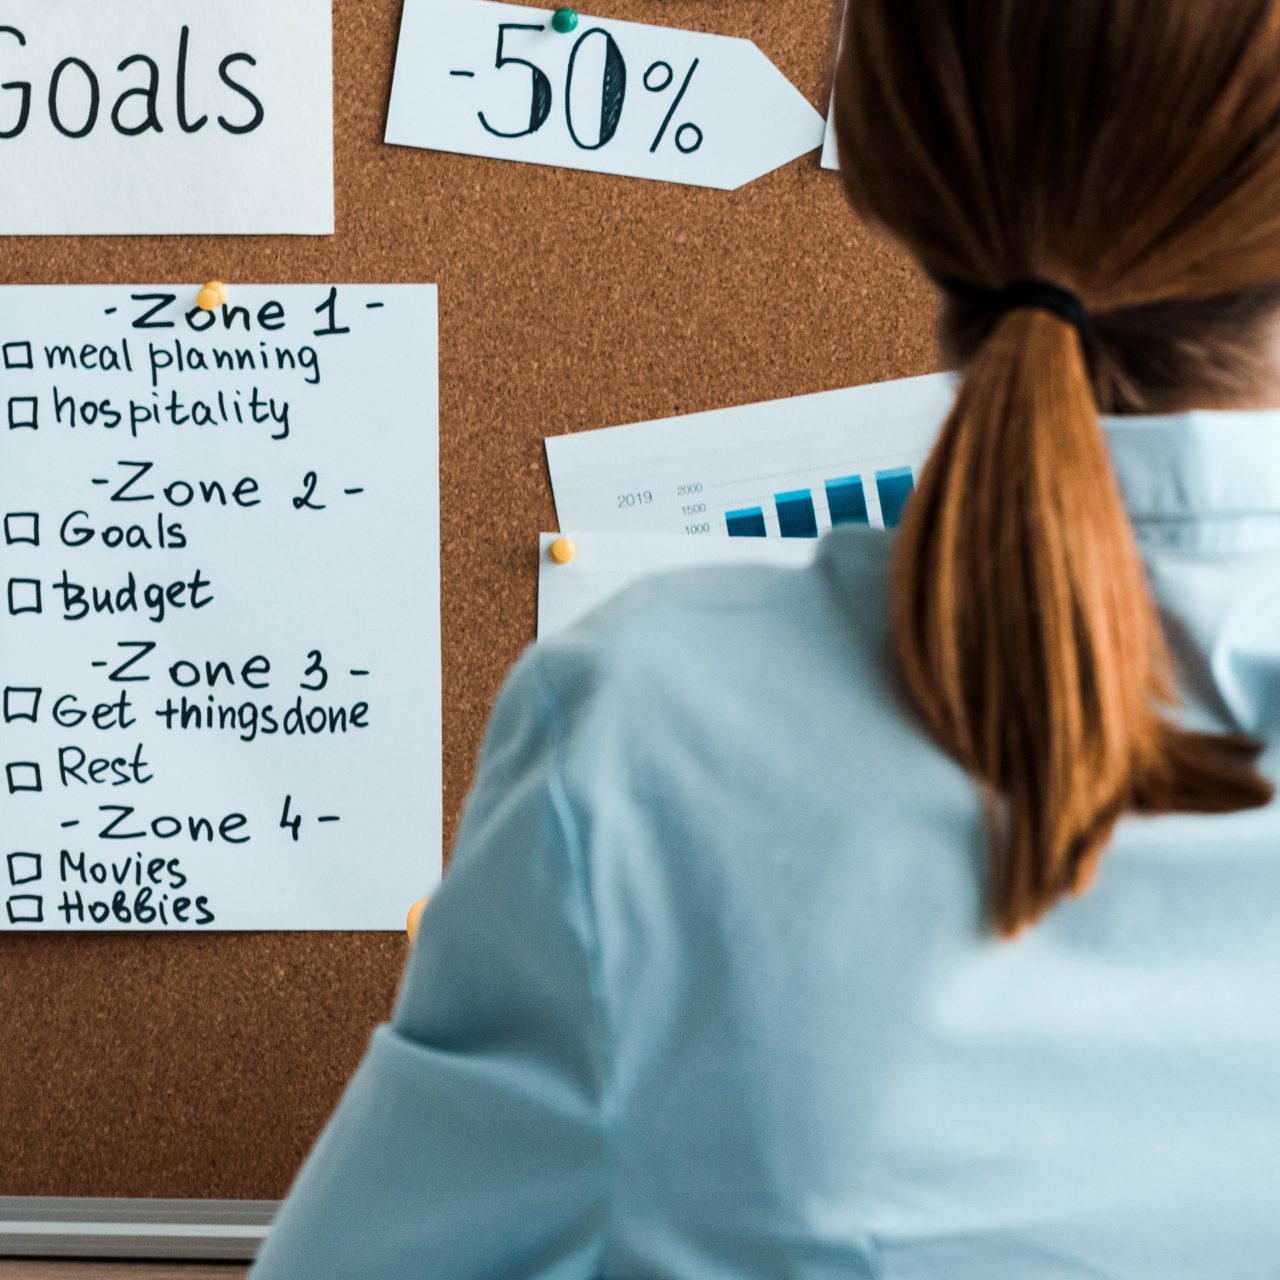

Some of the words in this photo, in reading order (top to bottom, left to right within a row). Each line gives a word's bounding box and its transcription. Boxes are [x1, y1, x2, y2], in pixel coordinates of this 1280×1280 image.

[44, 338, 132, 371] meal
[149, 338, 321, 387] planning
[53, 385, 290, 440] hospitality
[617, 490, 653, 509] 2019
[676, 482, 704, 496] 2000
[681, 502, 707, 515] 1500
[60, 510, 186, 549] Goals
[685, 522, 711, 535] 1000
[52, 569, 214, 622] Budget
[52, 690, 136, 730] Get
[58, 743, 153, 786] Rest
[59, 850, 188, 889] Movies
[57, 886, 216, 926] Hobbies
